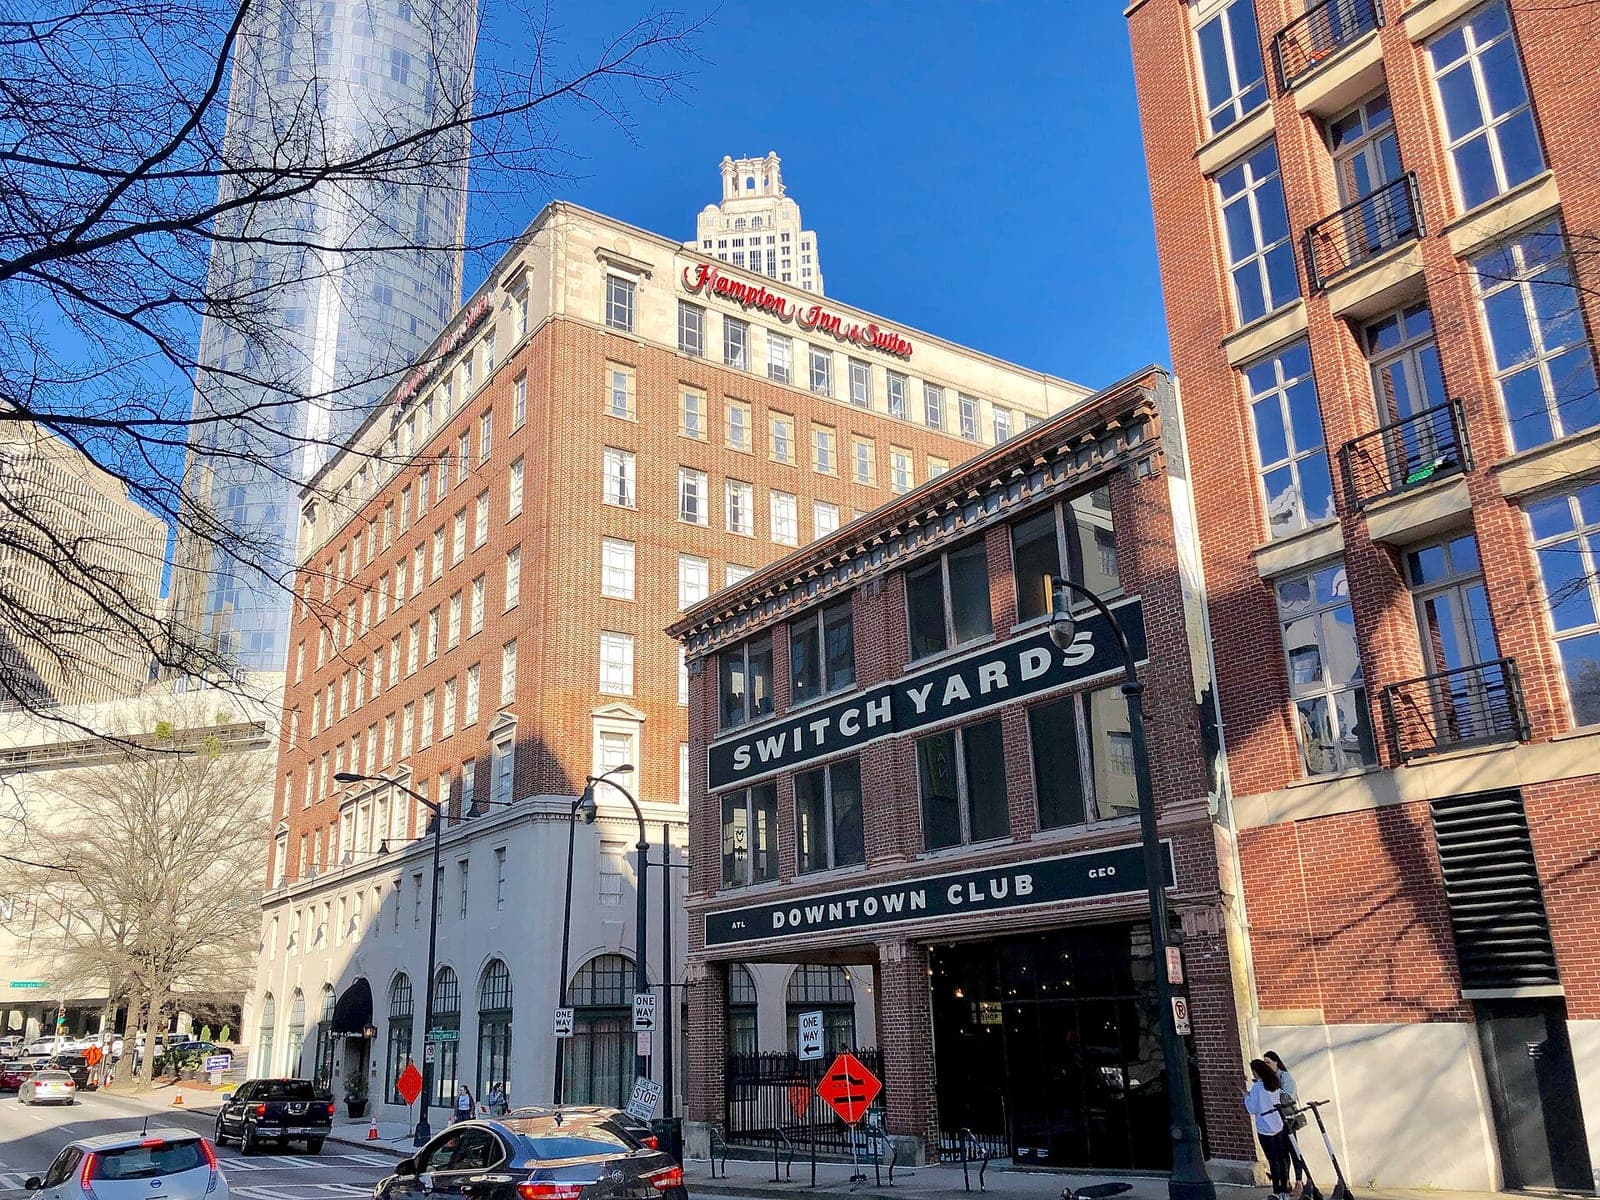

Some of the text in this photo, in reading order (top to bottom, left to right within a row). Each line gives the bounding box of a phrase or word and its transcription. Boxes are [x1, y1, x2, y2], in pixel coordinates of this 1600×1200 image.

[682, 263, 795, 320] Hampton
[800, 305, 850, 338] Inn
[863, 322, 914, 358] Suites
[732, 631, 1096, 772] SWITCH YARDS
[1088, 866, 1116, 879] GEO
[772, 874, 1034, 929] DOWNTOWN CLUB
[731, 921, 746, 930] ATL
[635, 996, 655, 1006] ONE
[555, 1010, 572, 1018] ONE
[635, 1007, 654, 1017] WAY
[802, 1016, 819, 1028] ONE
[802, 1030, 819, 1042] WAY
[633, 1087, 657, 1105] STOP
